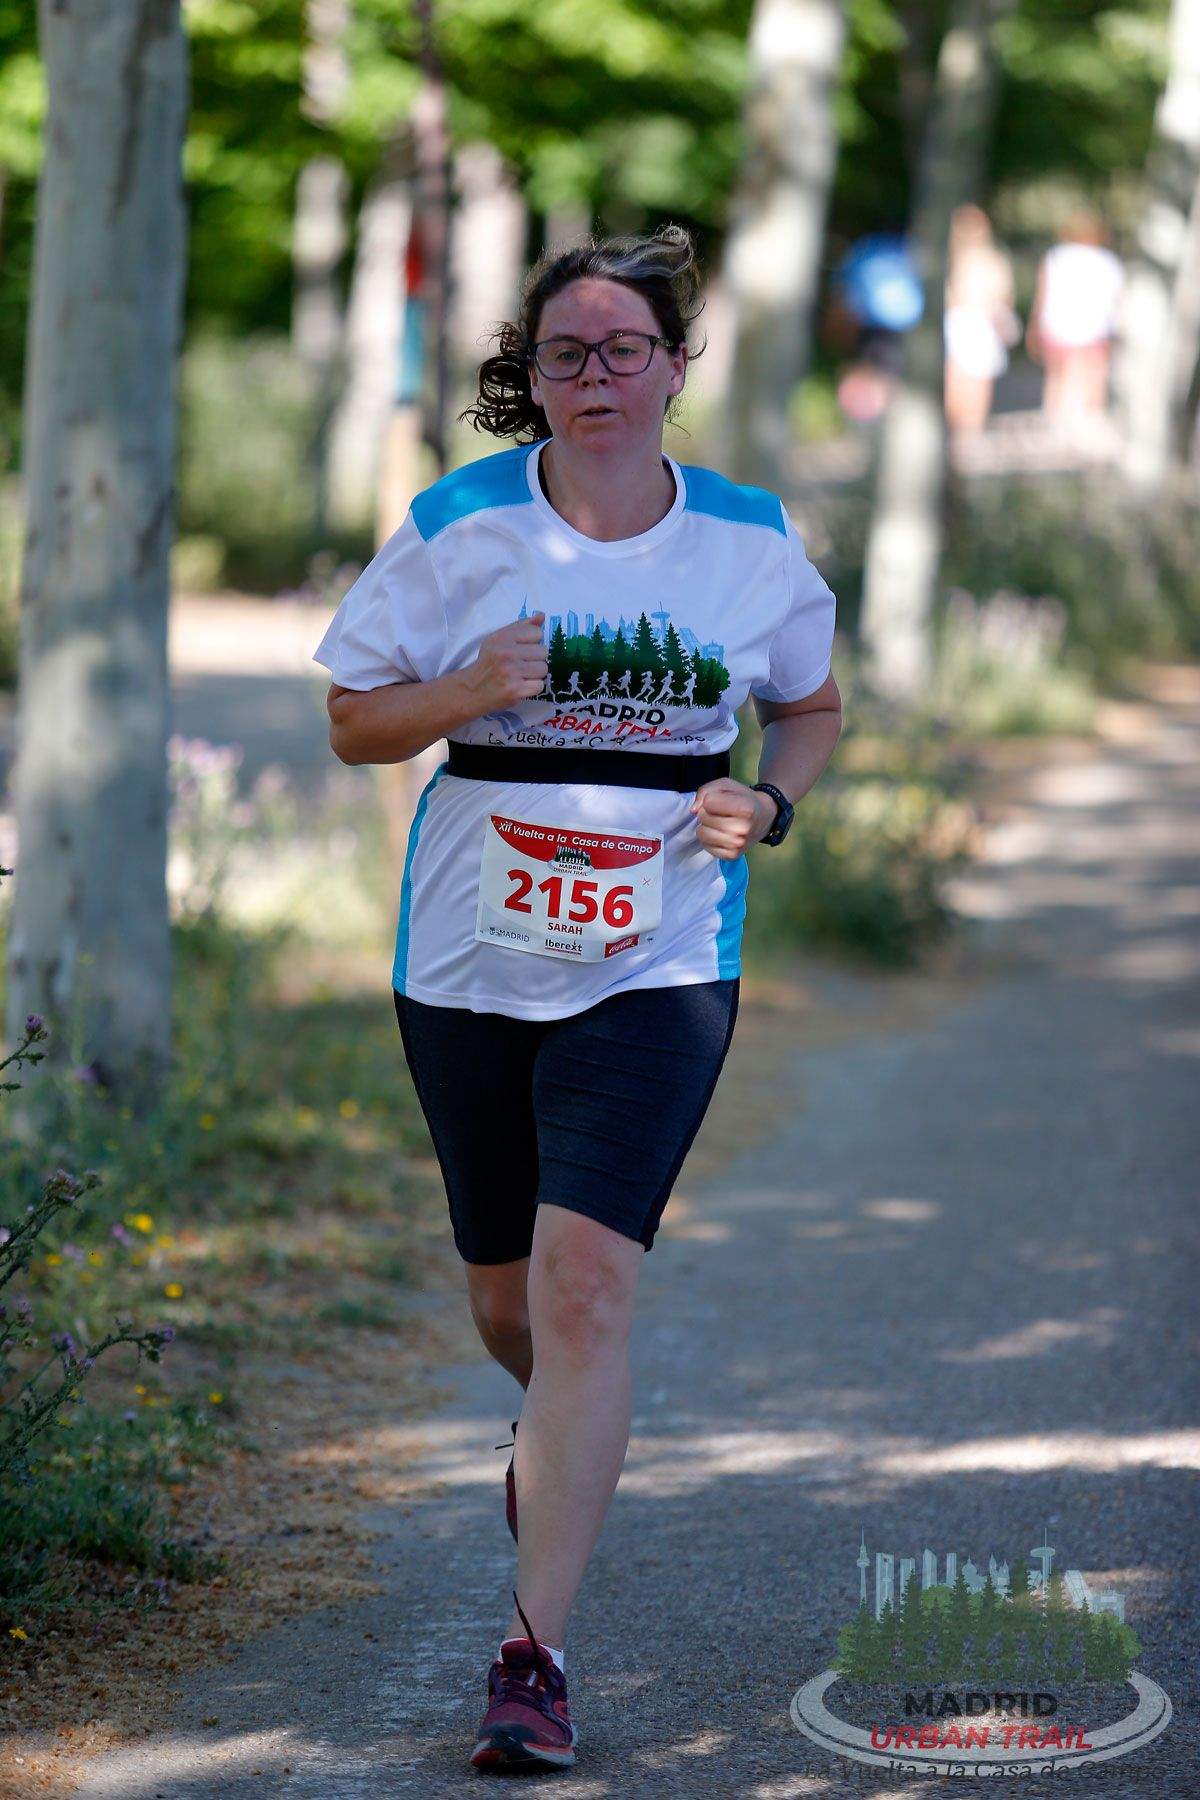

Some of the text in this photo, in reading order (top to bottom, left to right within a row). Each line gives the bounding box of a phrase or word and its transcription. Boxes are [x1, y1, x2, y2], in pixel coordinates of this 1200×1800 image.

[513, 826, 545, 840] Vuelta
[556, 834, 567, 843] la
[572, 836, 599, 848] Casa
[601, 840, 615, 849] de
[617, 841, 653, 855] Campo
[559, 863, 583, 871] MADRID
[504, 868, 634, 929] 2156
[547, 922, 583, 935] SARAH
[500, 929, 530, 943] MADRID
[545, 939, 582, 952] Iberext
